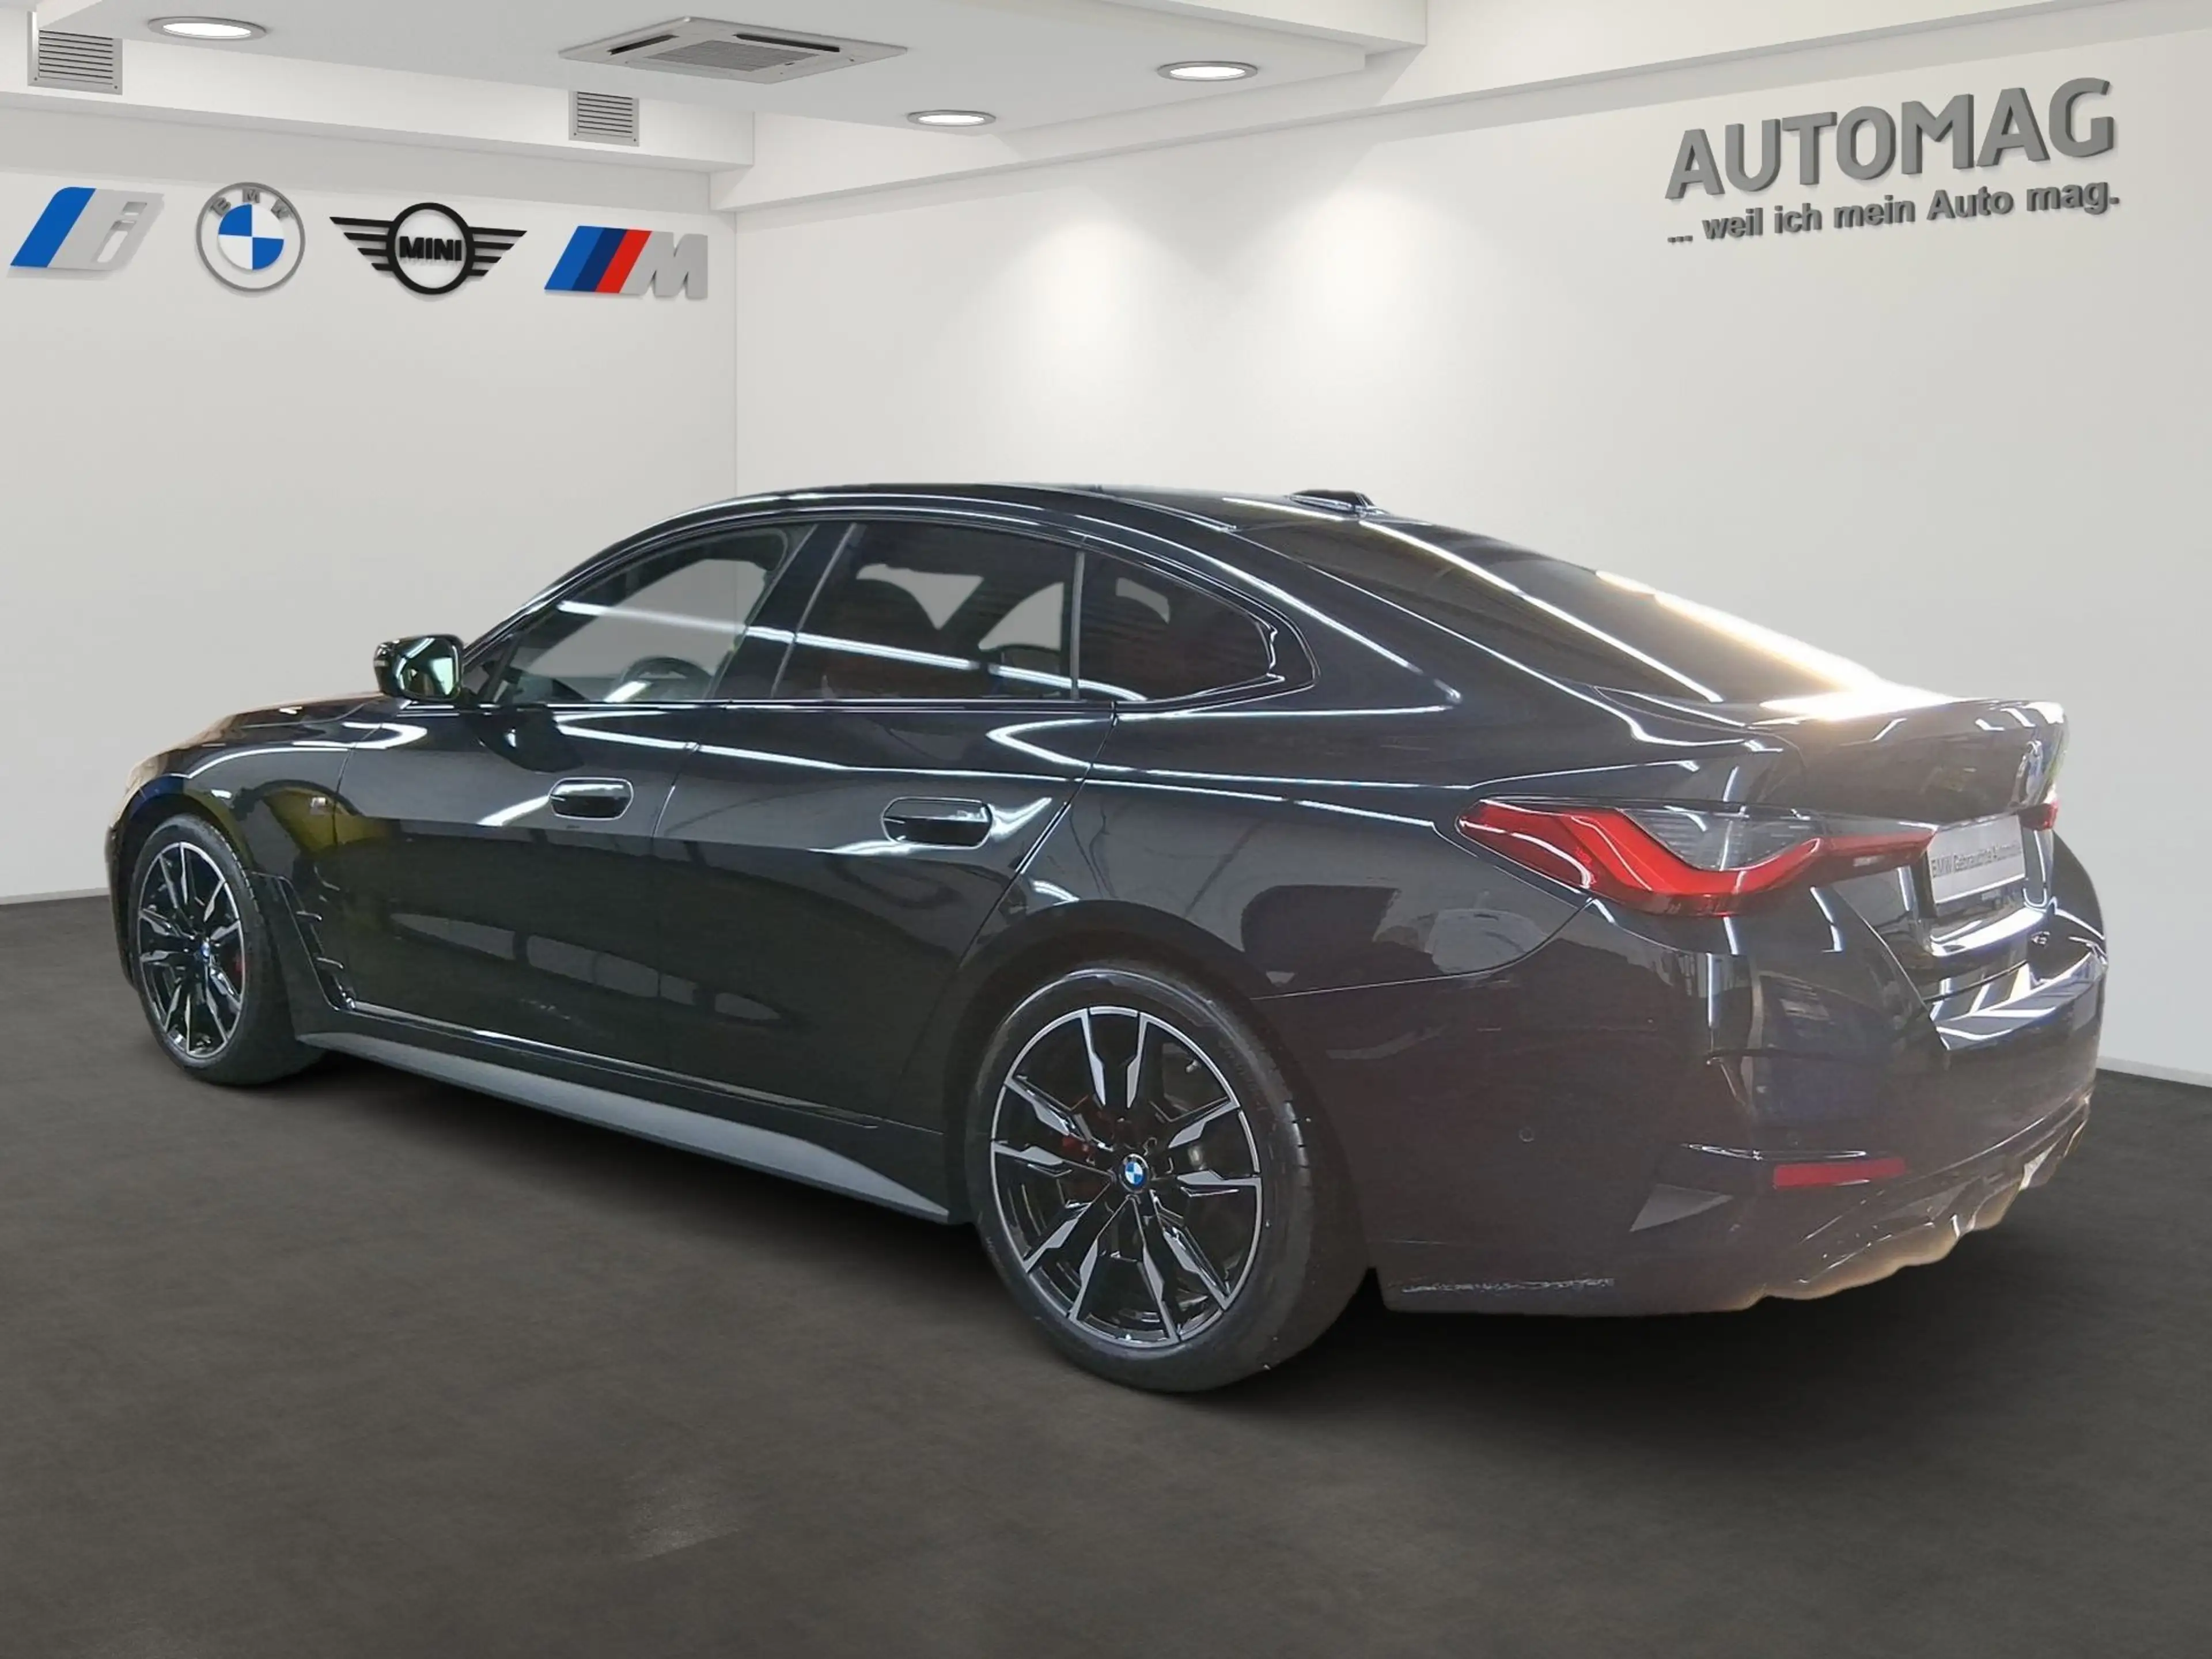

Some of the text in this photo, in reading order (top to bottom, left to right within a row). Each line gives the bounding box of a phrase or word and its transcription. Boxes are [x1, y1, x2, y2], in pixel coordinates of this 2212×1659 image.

[1665, 77, 2113, 199] AUTOMAG
[210, 188, 293, 220] BMW
[1702, 207, 1763, 240] weil
[1774, 202, 1822, 233] ich
[1834, 194, 1915, 229] mein
[1927, 185, 2014, 221] Auto
[2026, 181, 2120, 215] mag.
[399, 236, 462, 262] MINI
[1931, 855, 1953, 878] BMW
